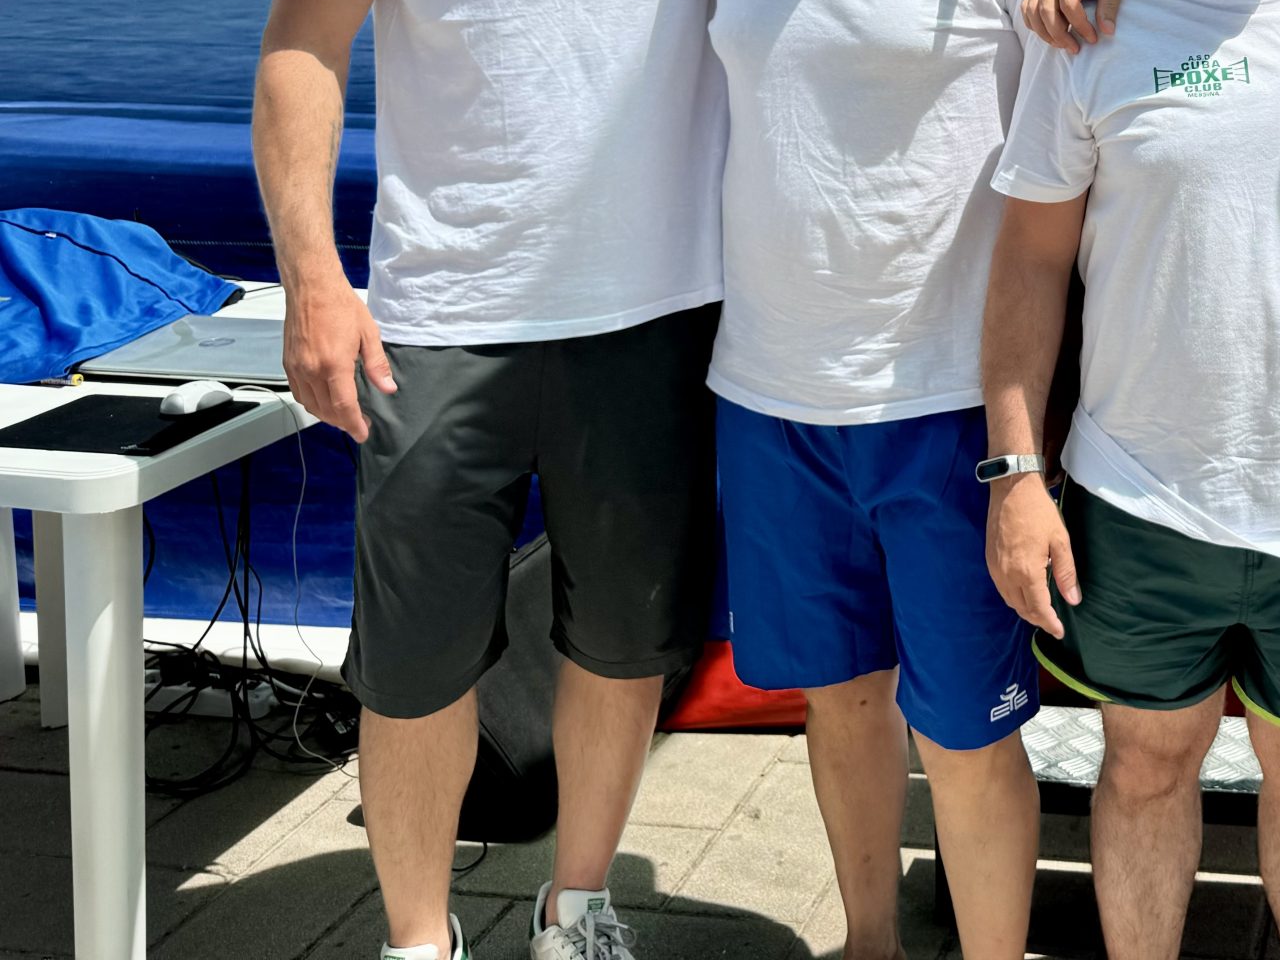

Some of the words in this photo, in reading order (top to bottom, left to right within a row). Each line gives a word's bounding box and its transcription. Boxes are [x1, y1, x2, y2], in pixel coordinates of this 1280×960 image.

[1180, 59, 1220, 71] CUBA
[1170, 67, 1234, 87] BOXE
[1184, 82, 1222, 93] CLUB
